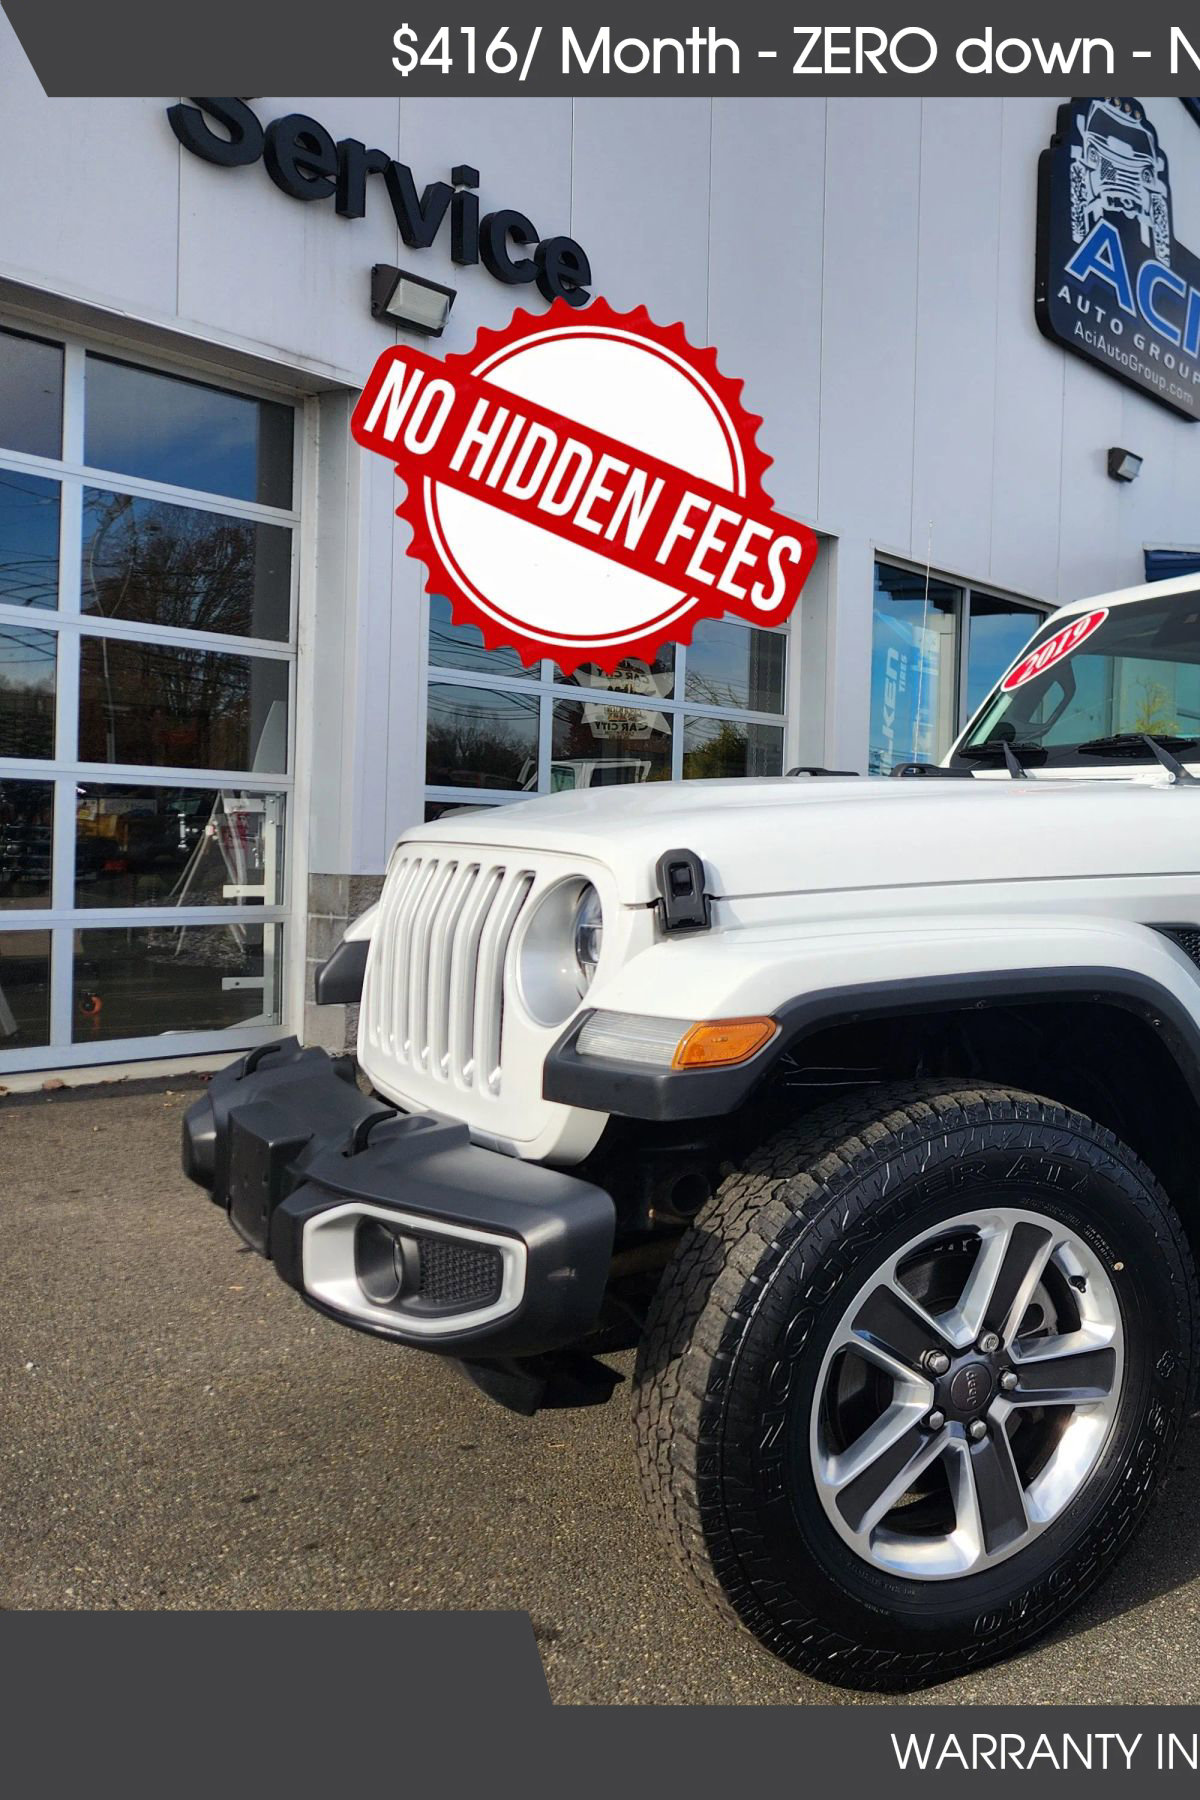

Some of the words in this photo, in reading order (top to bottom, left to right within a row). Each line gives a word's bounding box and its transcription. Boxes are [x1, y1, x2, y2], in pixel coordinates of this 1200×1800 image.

[166, 97, 592, 307] Service
[1058, 285, 1124, 336] AUTO
[1074, 320, 1194, 406] AciAutoGroup.com
[1016, 615, 1092, 684] 2019
